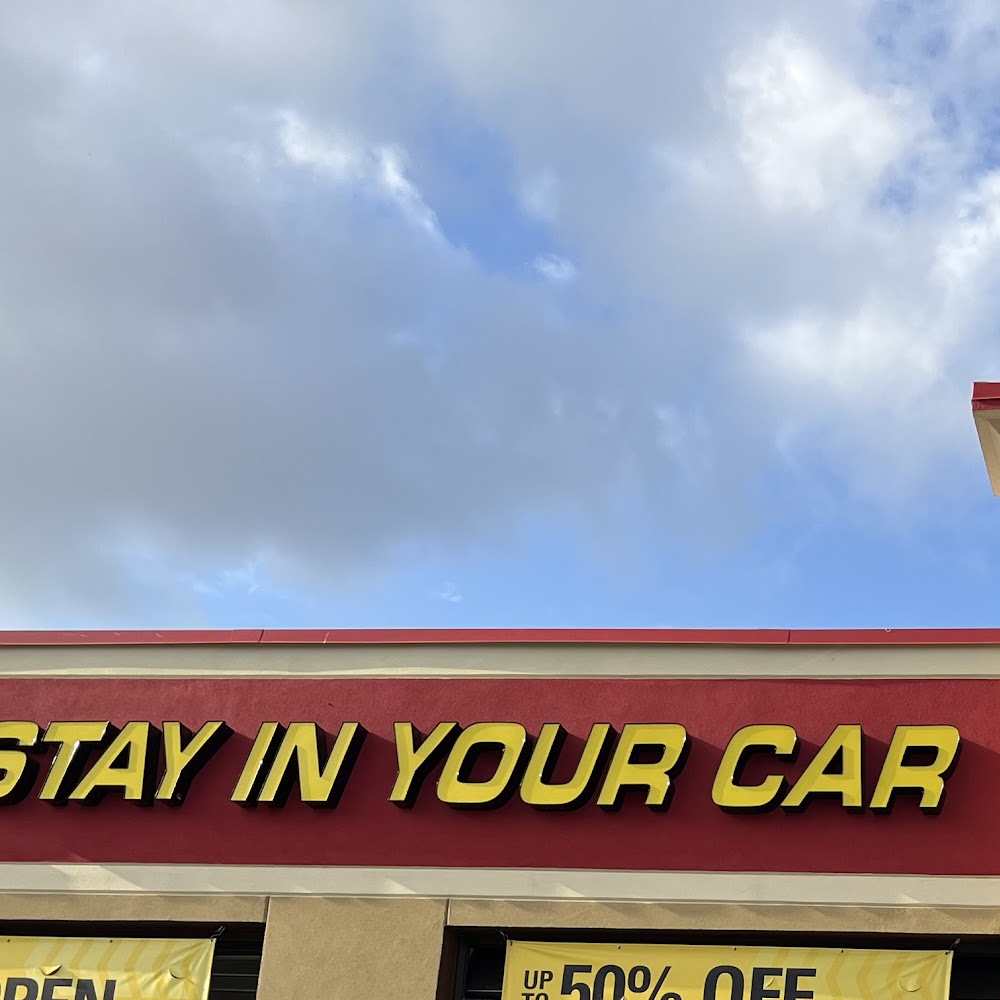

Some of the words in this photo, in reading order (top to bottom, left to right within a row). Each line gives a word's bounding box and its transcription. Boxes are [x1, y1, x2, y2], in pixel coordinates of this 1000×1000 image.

[0, 720, 229, 803] STAY
[230, 720, 364, 804] IN
[389, 721, 688, 807] YOUR
[711, 723, 962, 810] CAR
[523, 970, 554, 990] UP
